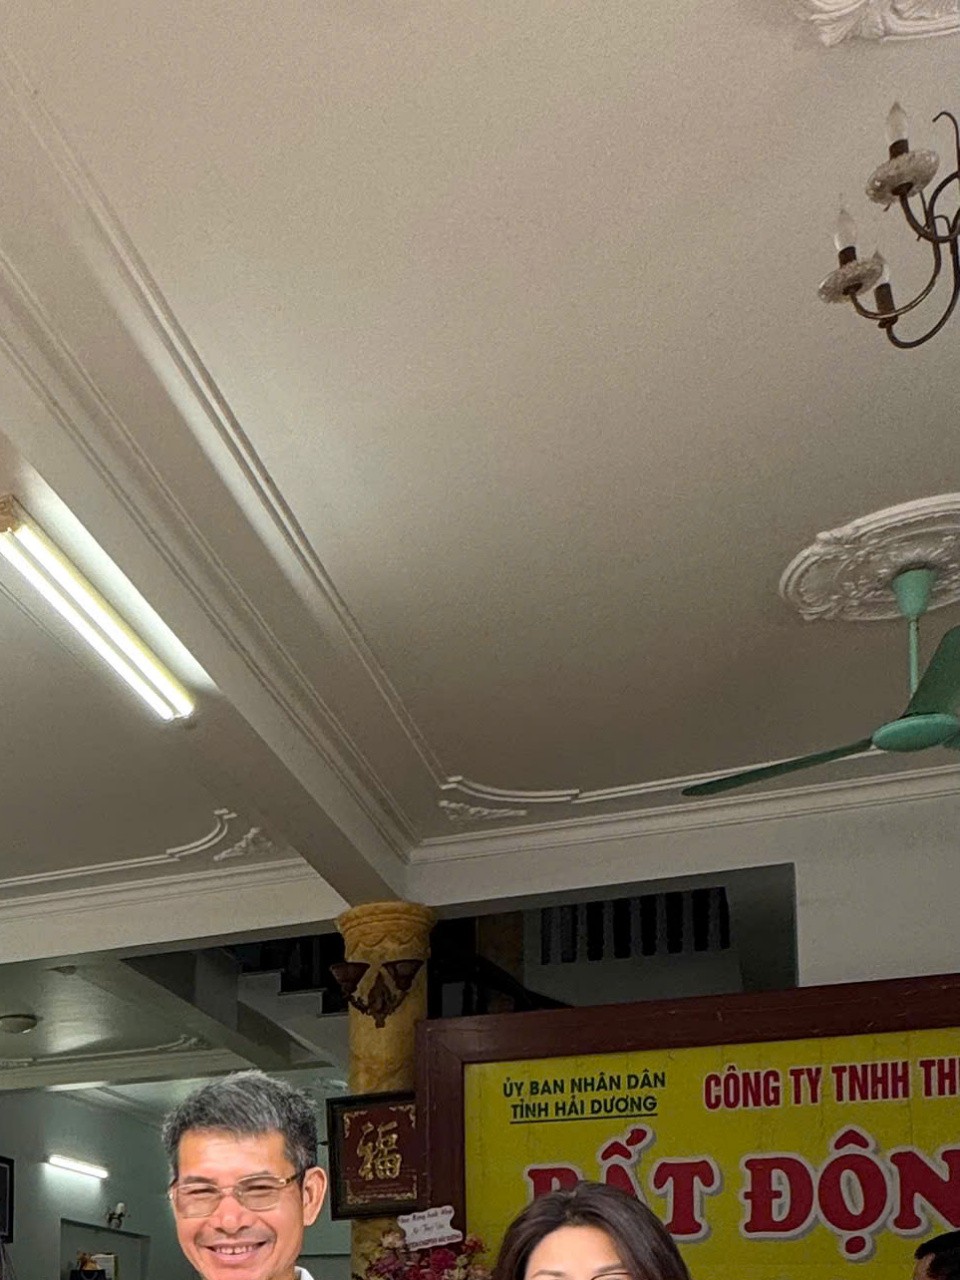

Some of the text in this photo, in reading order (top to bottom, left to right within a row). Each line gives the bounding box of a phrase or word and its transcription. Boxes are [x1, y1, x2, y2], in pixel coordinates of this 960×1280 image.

[530, 1079, 564, 1096] BAN
[570, 1071, 621, 1093] NHÂN
[627, 1068, 666, 1090] DÂN
[704, 1057, 960, 1110] CÔNG TY TNHH TH
[554, 1094, 585, 1117] HẢI
[591, 1095, 658, 1114] DƯƠNG
